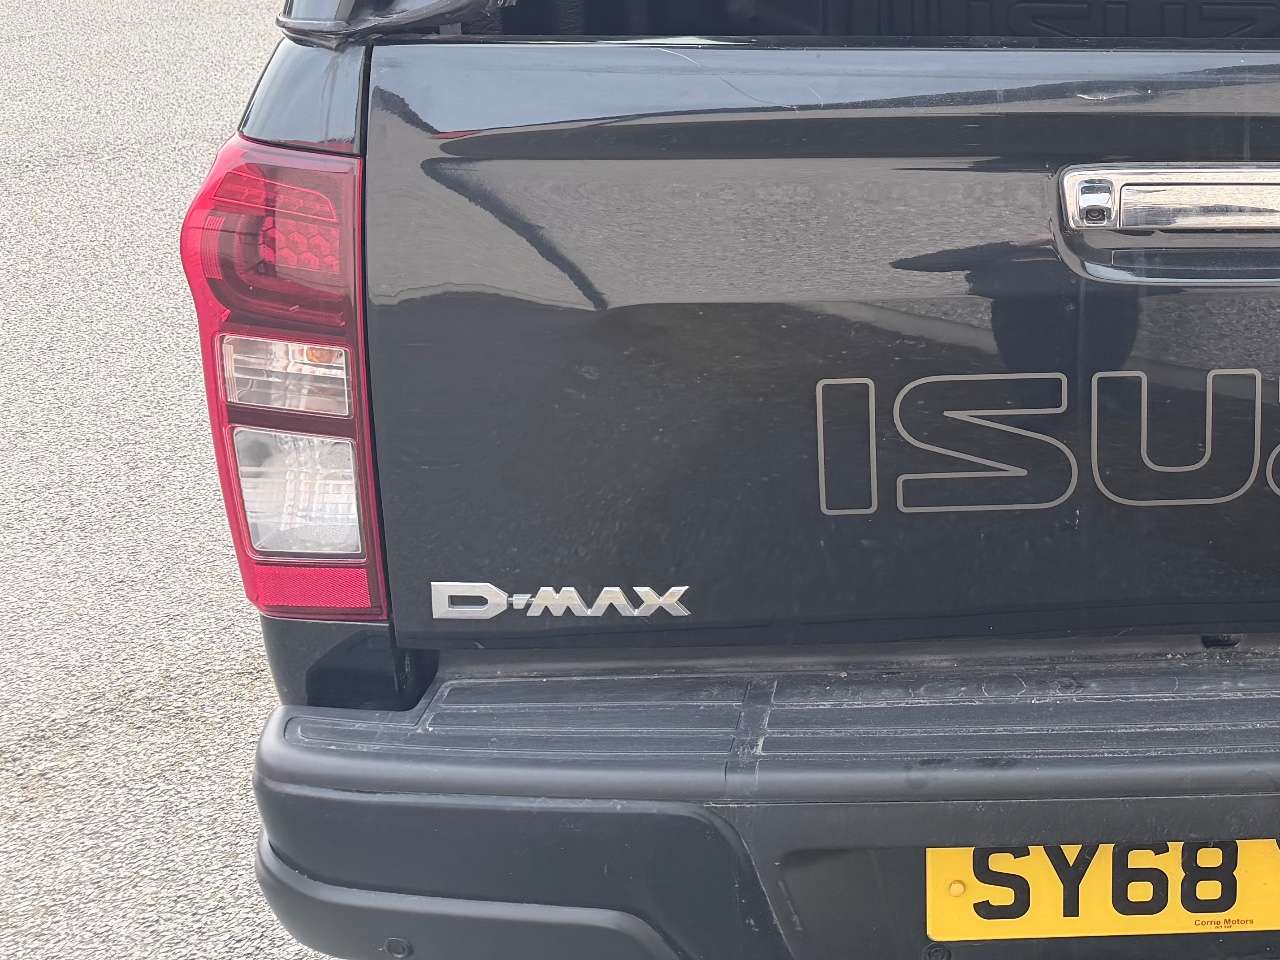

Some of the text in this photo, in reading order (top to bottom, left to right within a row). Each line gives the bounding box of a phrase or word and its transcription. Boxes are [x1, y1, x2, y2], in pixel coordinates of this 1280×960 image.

[430, 581, 692, 620] D-MAX
[972, 841, 1239, 921] SY68
[1223, 918, 1255, 926] Motors
